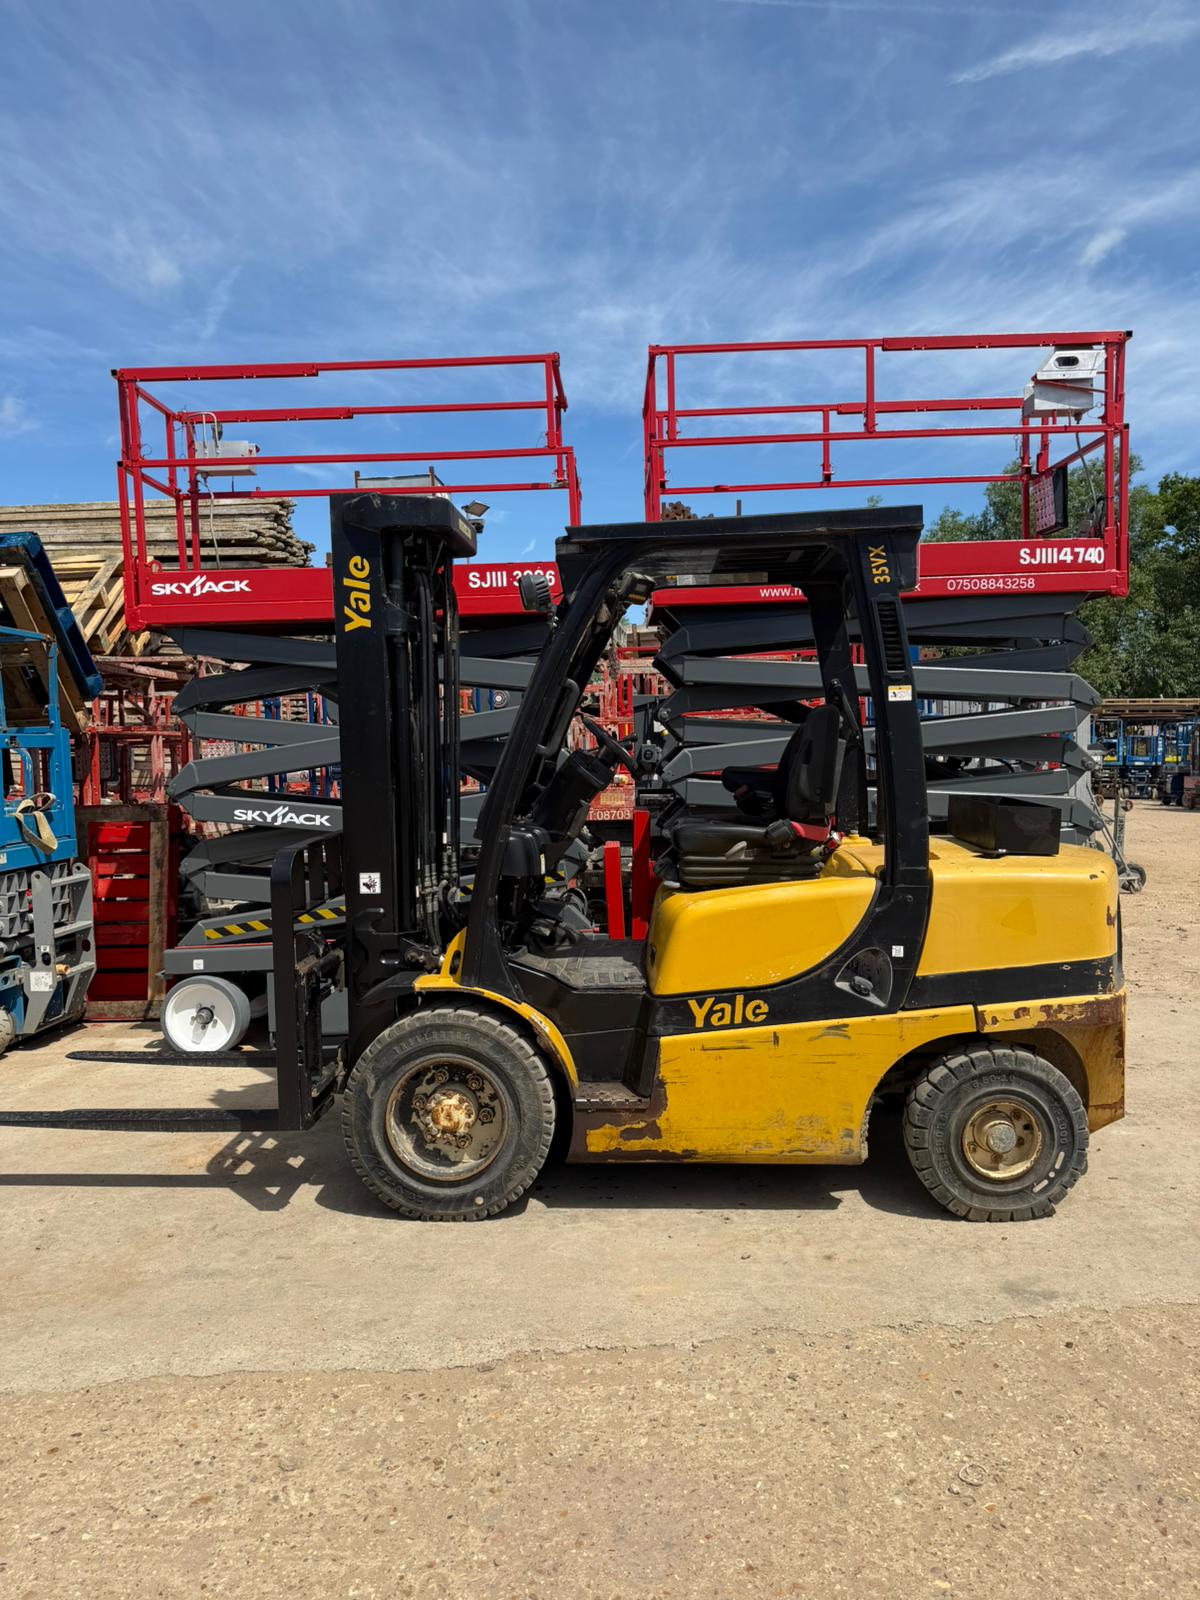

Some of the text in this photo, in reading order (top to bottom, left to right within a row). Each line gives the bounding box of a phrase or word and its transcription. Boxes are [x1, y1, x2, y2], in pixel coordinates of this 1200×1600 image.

[868, 545, 890, 584] 35VX
[151, 575, 252, 596] SKYJACK
[468, 571, 507, 588] SJIII
[947, 577, 1035, 590] 07508843258
[343, 555, 371, 632] Yale
[233, 805, 332, 826] SKYJACK
[687, 994, 769, 1028] Yale
